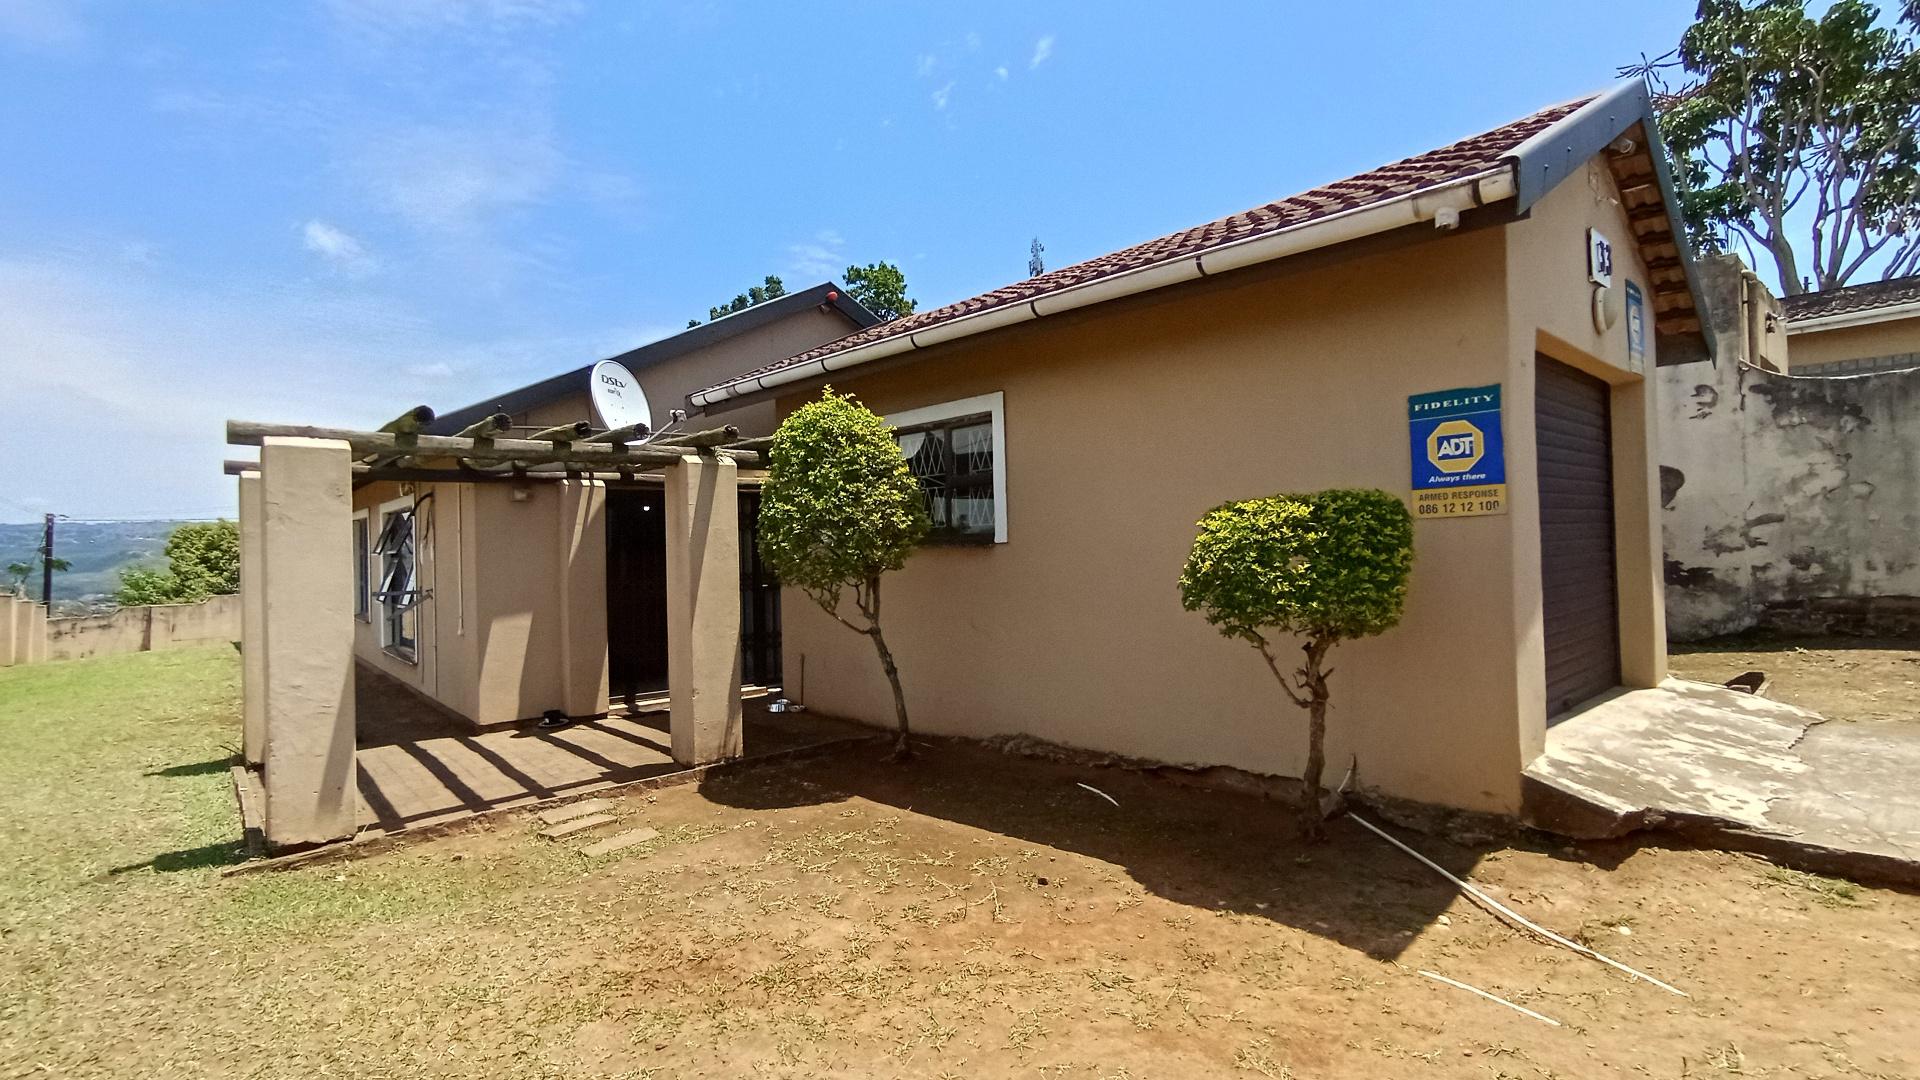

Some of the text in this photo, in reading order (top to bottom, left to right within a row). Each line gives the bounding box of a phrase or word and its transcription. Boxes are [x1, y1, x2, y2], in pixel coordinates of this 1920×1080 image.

[1596, 240, 1612, 276] 33
[601, 374, 627, 388] DStv
[1414, 394, 1494, 412] FIDELITY
[1438, 436, 1474, 456] ADT
[1428, 473, 1486, 483] Always there
[1419, 489, 1499, 502] ARMED RESPONSE
[1418, 500, 1500, 515] 086 12 12 100
